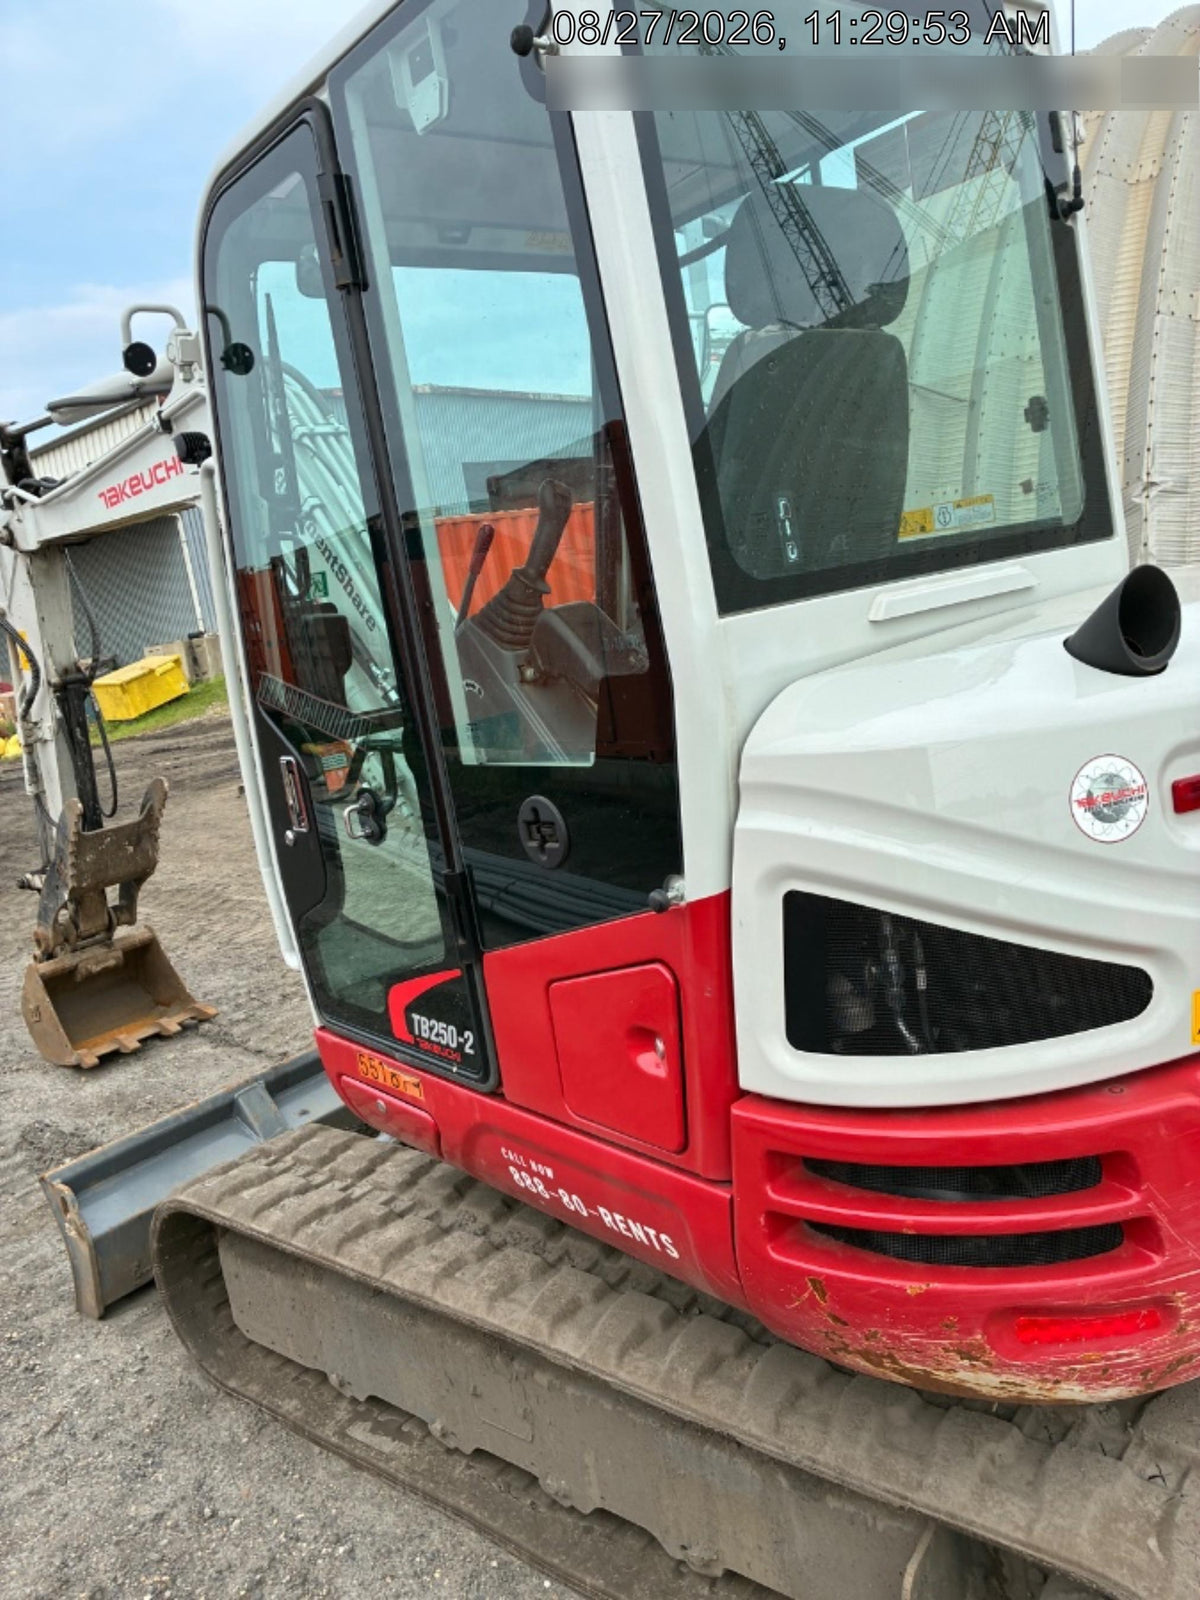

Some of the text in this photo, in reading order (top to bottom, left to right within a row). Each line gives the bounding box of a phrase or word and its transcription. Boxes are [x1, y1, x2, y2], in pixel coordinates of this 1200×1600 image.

[411, 1013, 475, 1055] TB250-2
[501, 1147, 554, 1179] CALL NOW
[508, 1165, 680, 1259] 888-80-RENTS
